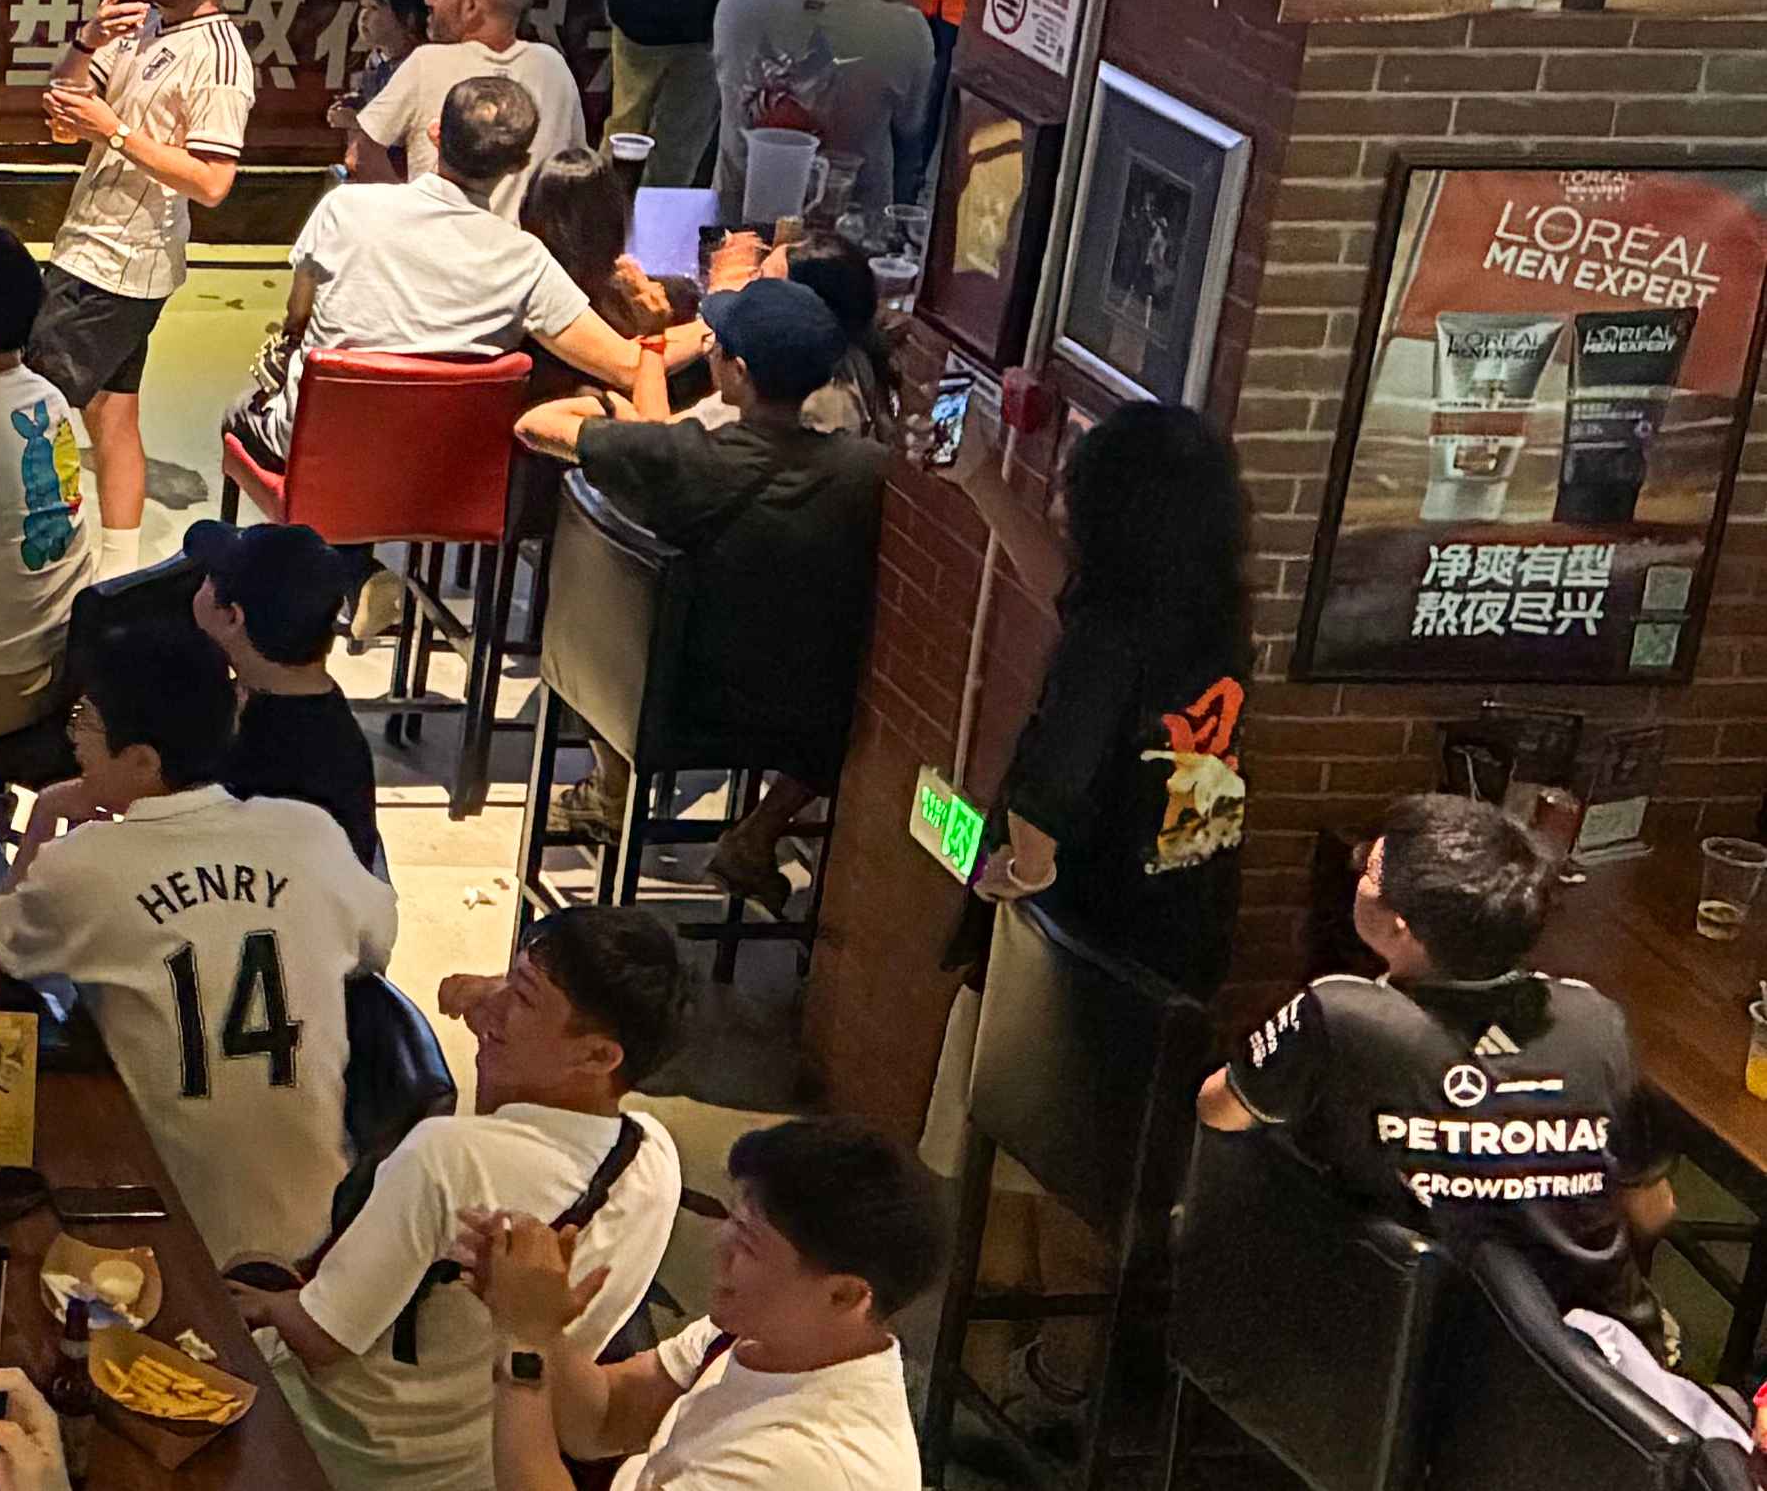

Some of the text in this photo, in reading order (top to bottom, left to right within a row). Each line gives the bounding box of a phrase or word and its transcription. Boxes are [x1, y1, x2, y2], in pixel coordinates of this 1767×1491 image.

[1494, 200, 1721, 283] L'ORÉAL
[1483, 241, 1718, 309] MEN EXPERT
[1421, 543, 1616, 588] 净爽有型
[1411, 590, 1605, 637] 熬夜尽兴
[138, 861, 290, 925] HENRY
[163, 928, 302, 1101] 14
